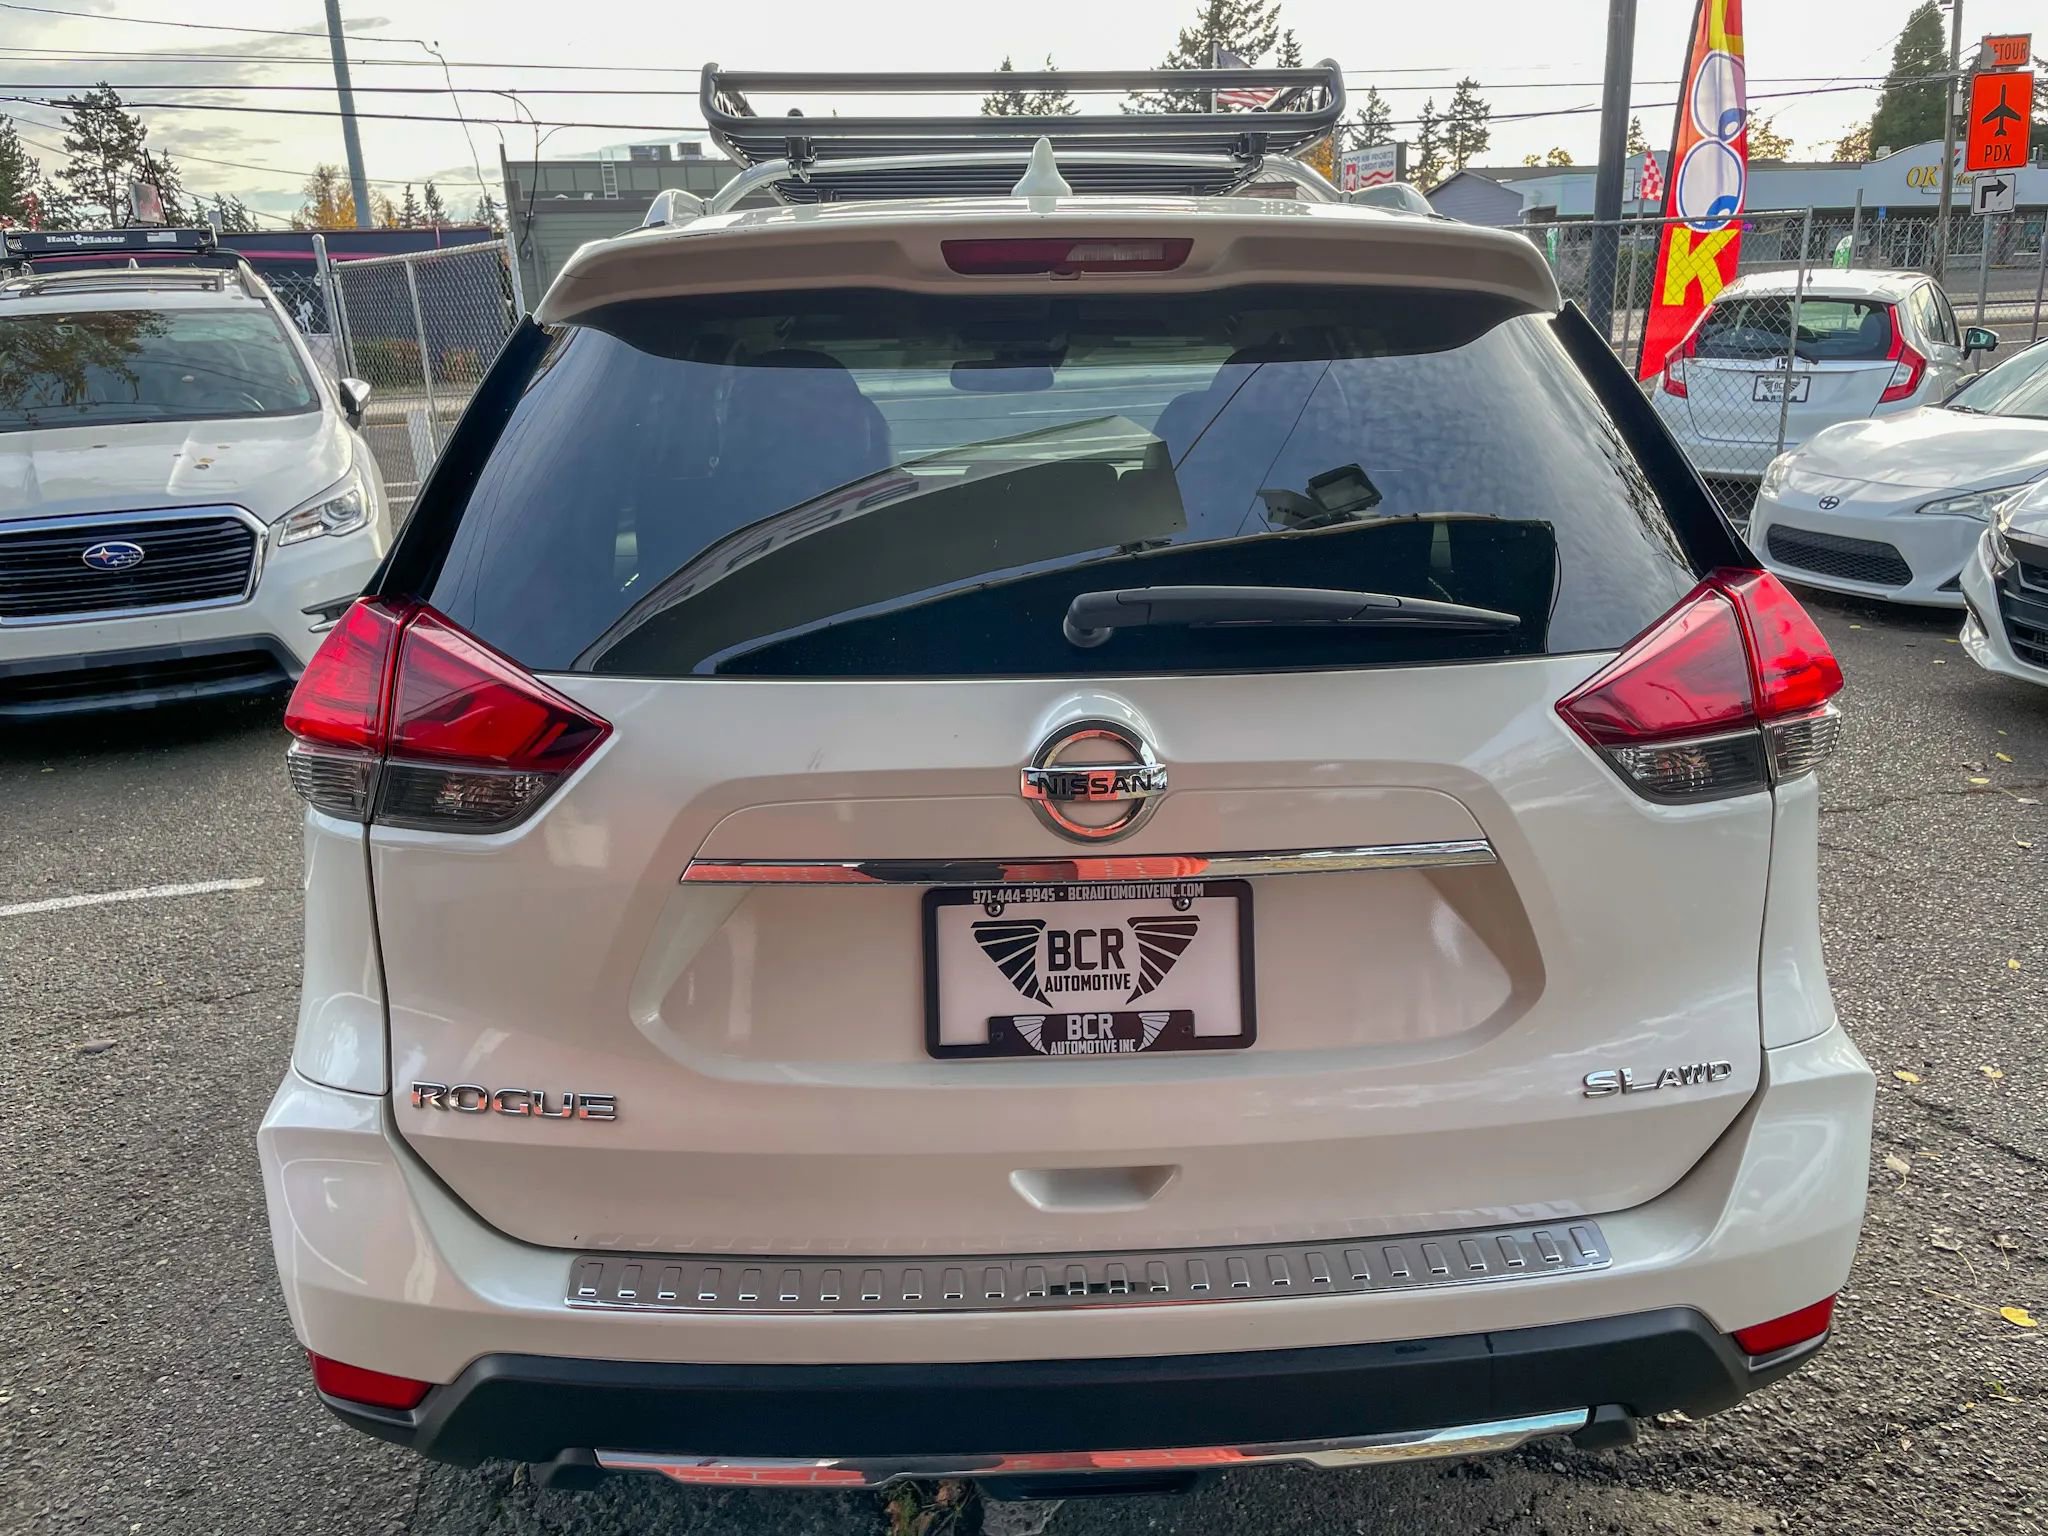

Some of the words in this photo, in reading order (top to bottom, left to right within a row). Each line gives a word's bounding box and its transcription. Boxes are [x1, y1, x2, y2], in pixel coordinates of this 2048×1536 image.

[1984, 144, 2012, 162] PDX
[1906, 165, 1939, 188] OK
[82, 235, 125, 244] Master
[1037, 774, 1152, 796] NISSAN
[972, 888, 1056, 903] 971-444-9945
[1067, 883, 1205, 901] BCRAUTOMOTIVEINC.COM
[1047, 928, 1126, 972] BCR
[1044, 973, 1131, 992] AUTOMOTIVE
[1066, 1013, 1114, 1040] BCR
[1050, 1039, 1118, 1055] AUTOMOTIVE
[1119, 1038, 1136, 1053] INC
[411, 1080, 617, 1122] ROGUE
